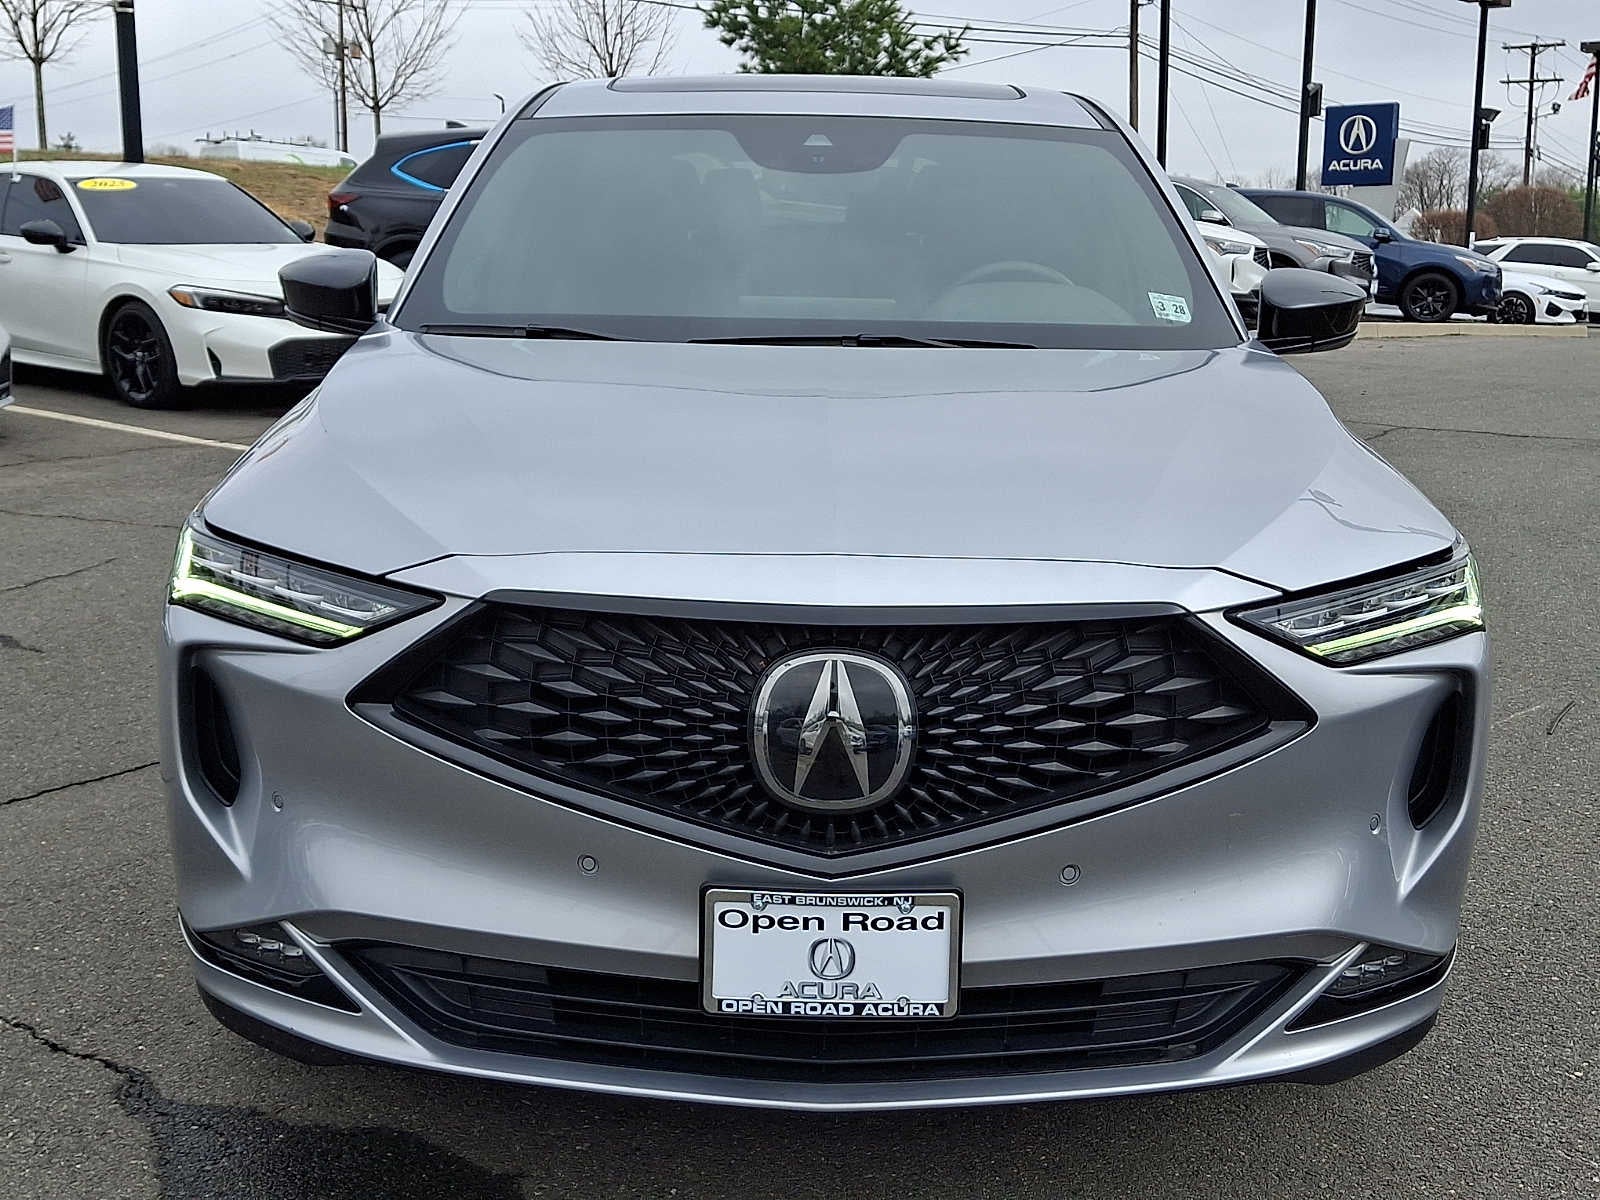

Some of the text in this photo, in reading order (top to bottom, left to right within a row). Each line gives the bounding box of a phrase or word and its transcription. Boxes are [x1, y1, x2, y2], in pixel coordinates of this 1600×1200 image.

[1328, 158, 1383, 171] ACURA
[1157, 301, 1166, 311] 3
[1172, 304, 1186, 315] 28
[753, 894, 912, 906] EAST BRUNSWICK, NJ
[718, 909, 944, 933] Open Road
[777, 981, 882, 1000] ACURA
[721, 1000, 940, 1016] OPEN ROAD ACURA
